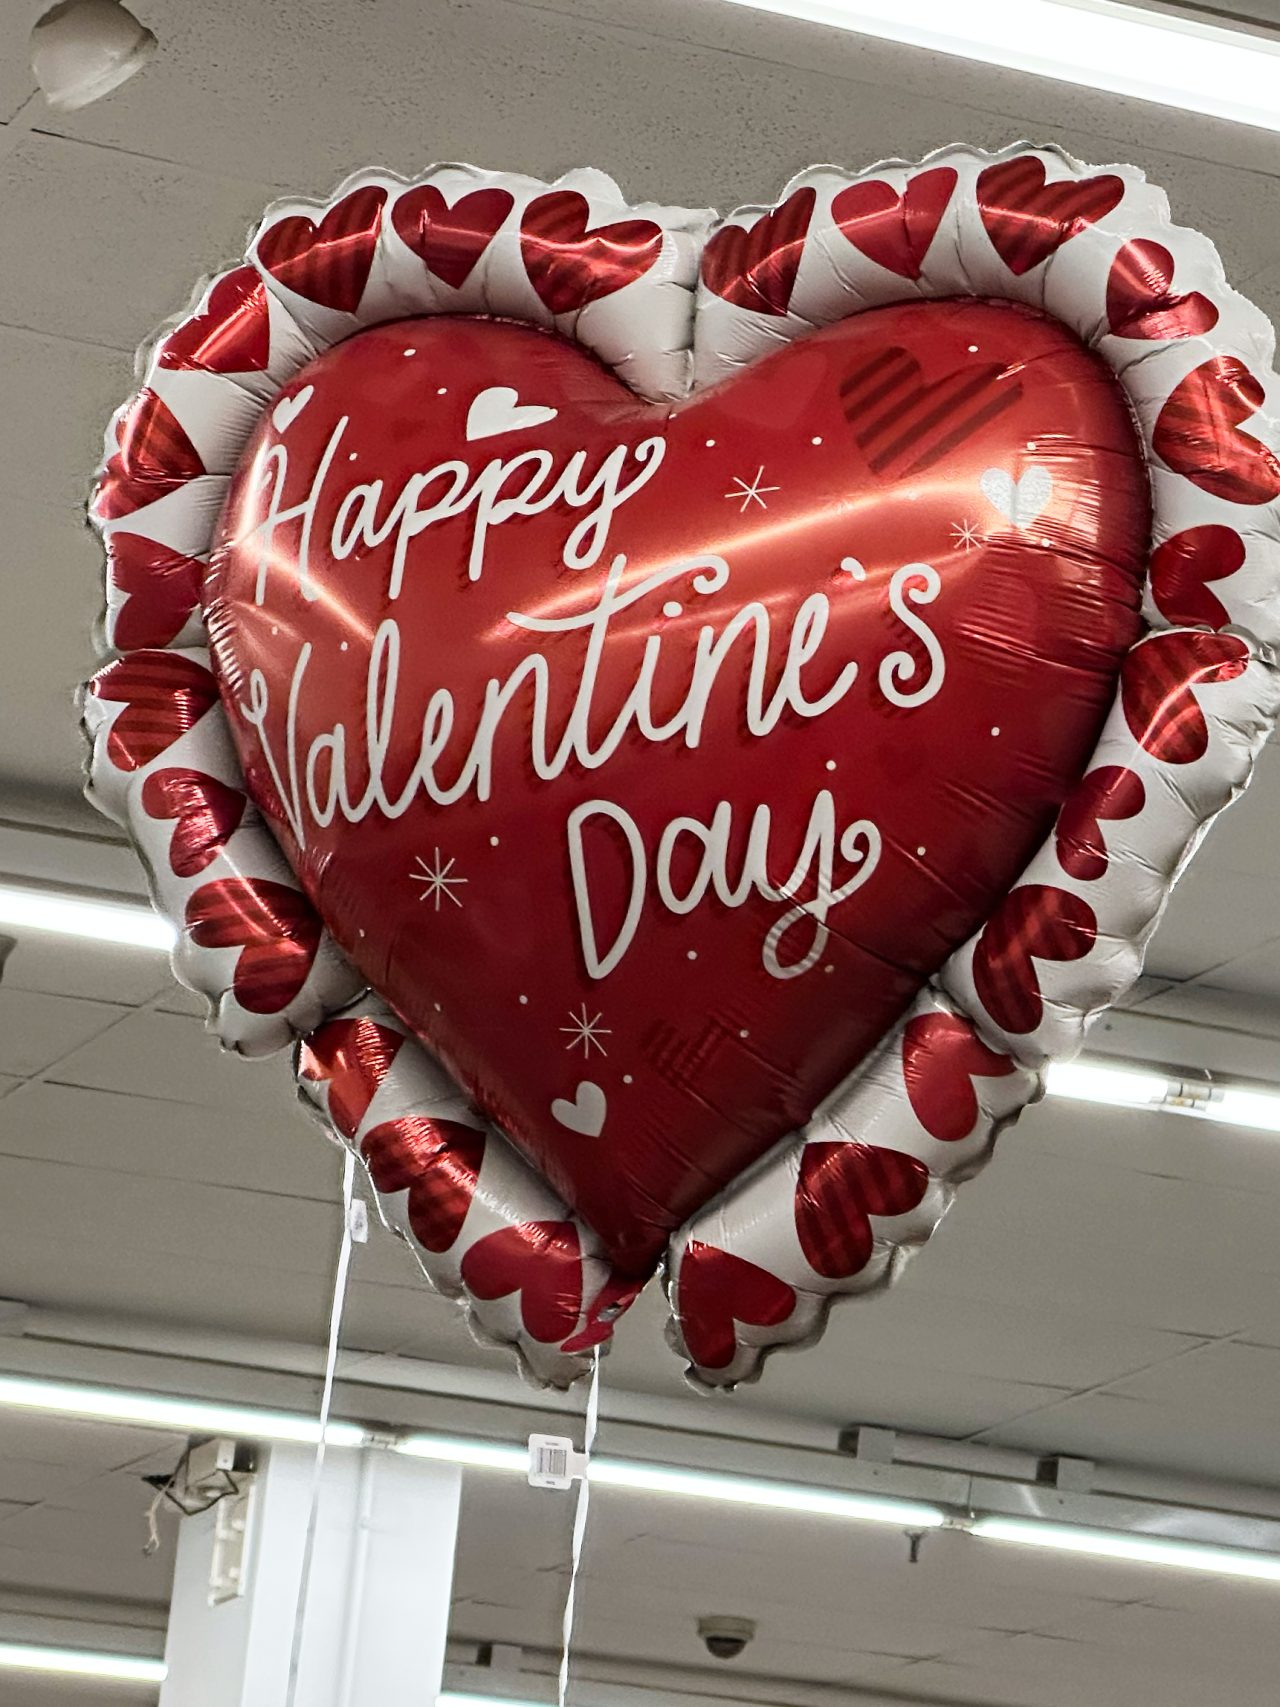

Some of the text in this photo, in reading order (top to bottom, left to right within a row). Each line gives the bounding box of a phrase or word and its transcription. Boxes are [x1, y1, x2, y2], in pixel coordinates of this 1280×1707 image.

[246, 416, 667, 605] Happy
[240, 553, 946, 851] Valentine's
[567, 789, 882, 980] Day
